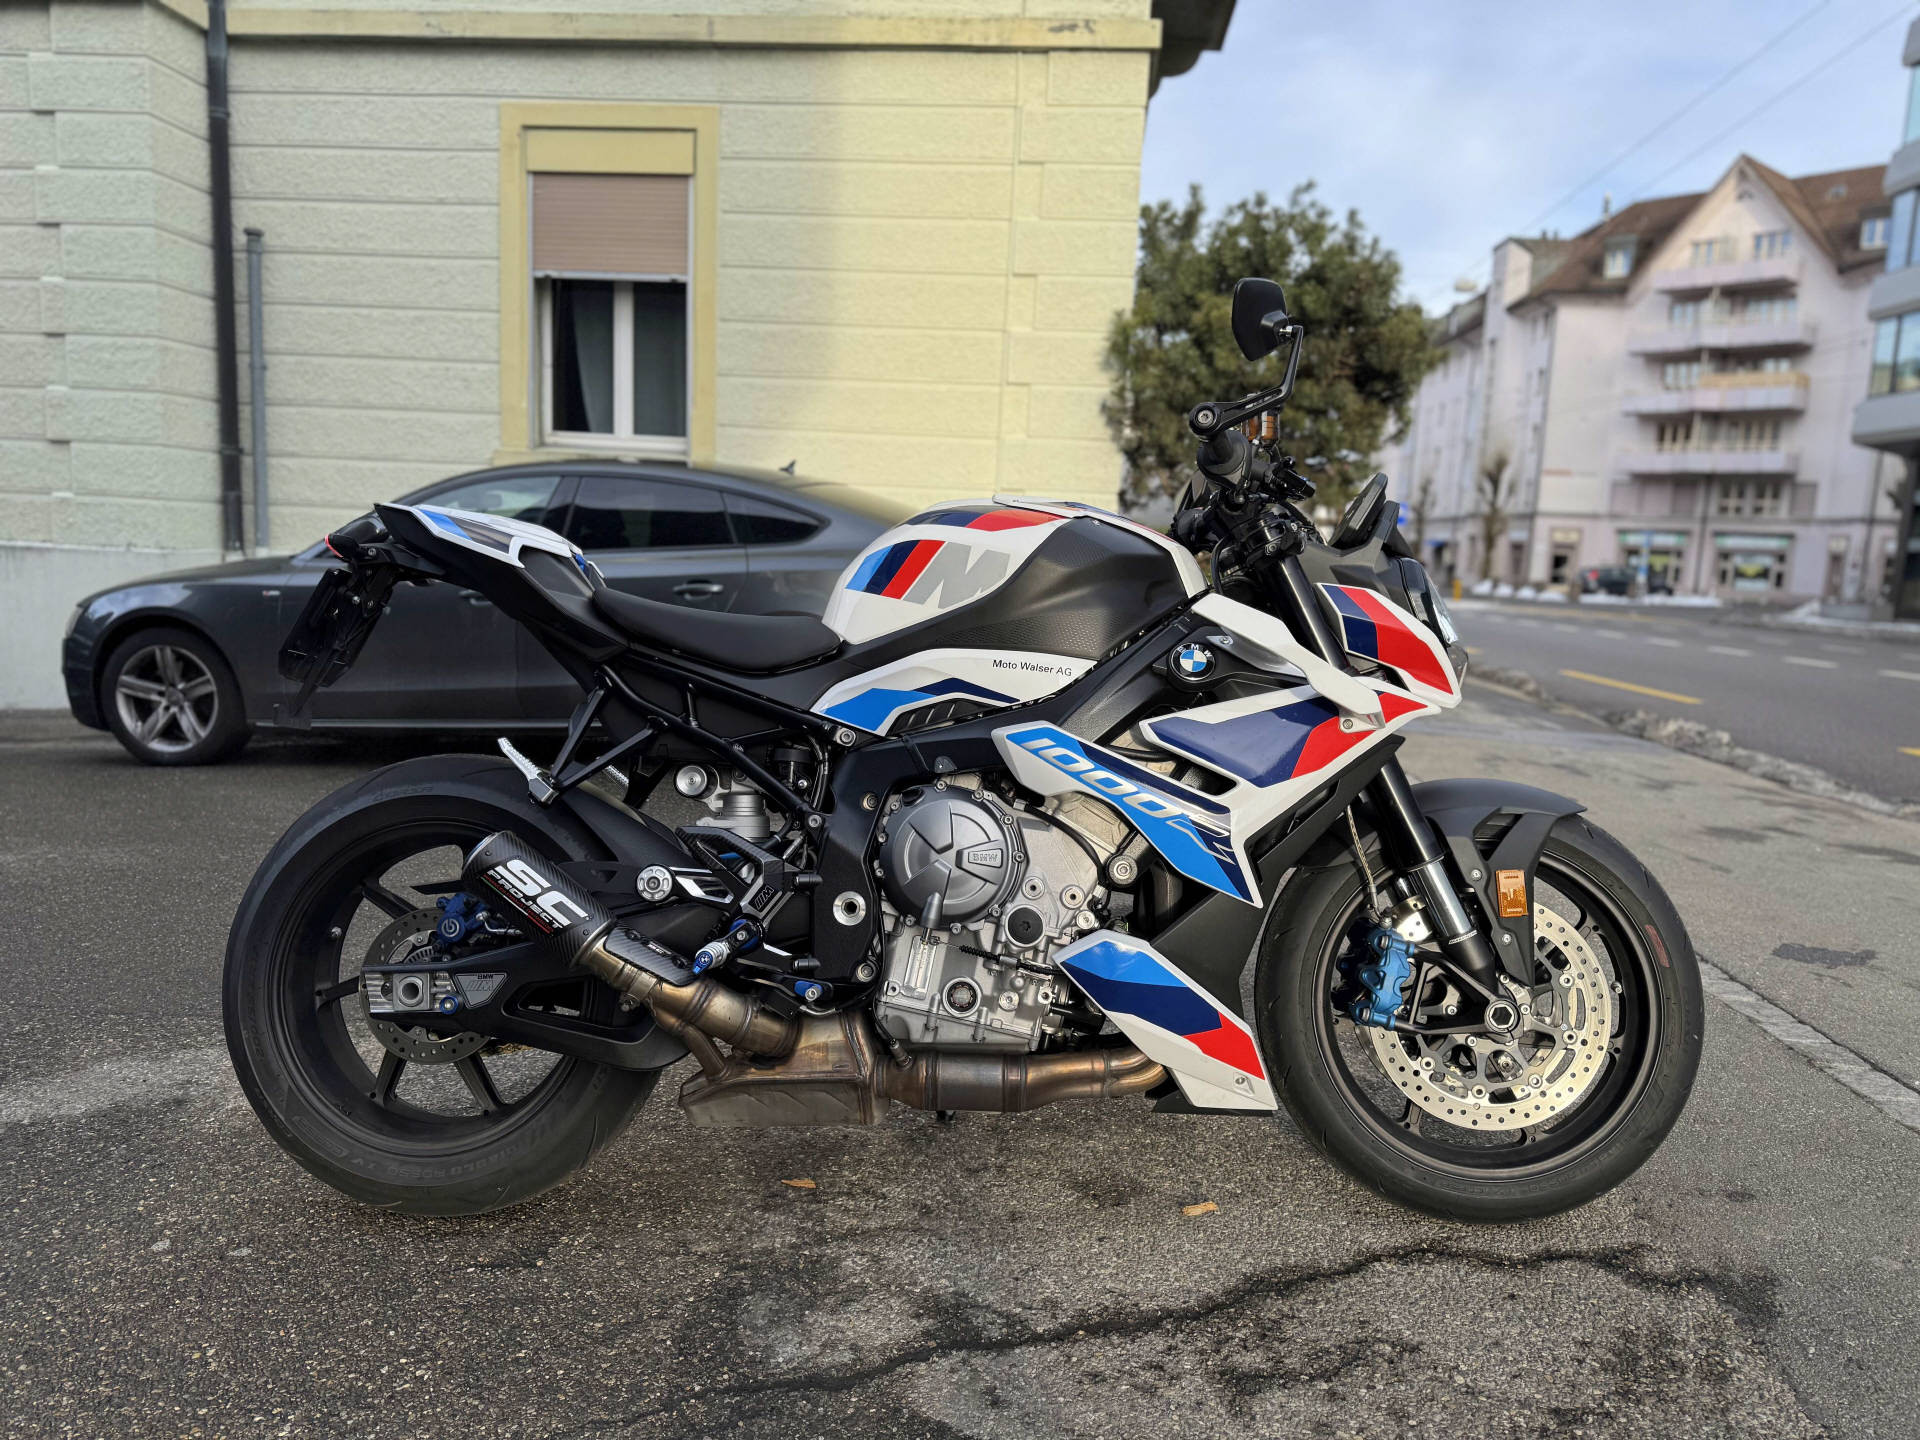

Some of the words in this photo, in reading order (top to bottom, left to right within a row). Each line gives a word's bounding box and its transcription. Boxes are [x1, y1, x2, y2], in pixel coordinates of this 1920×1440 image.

[1177, 643, 1212, 658] BMW
[992, 659, 1018, 670] Moto
[1020, 661, 1054, 674] Walser
[1056, 666, 1072, 677] AG
[972, 852, 998, 862] BMW
[486, 869, 563, 929] PROJECT
[494, 859, 588, 927] SC
